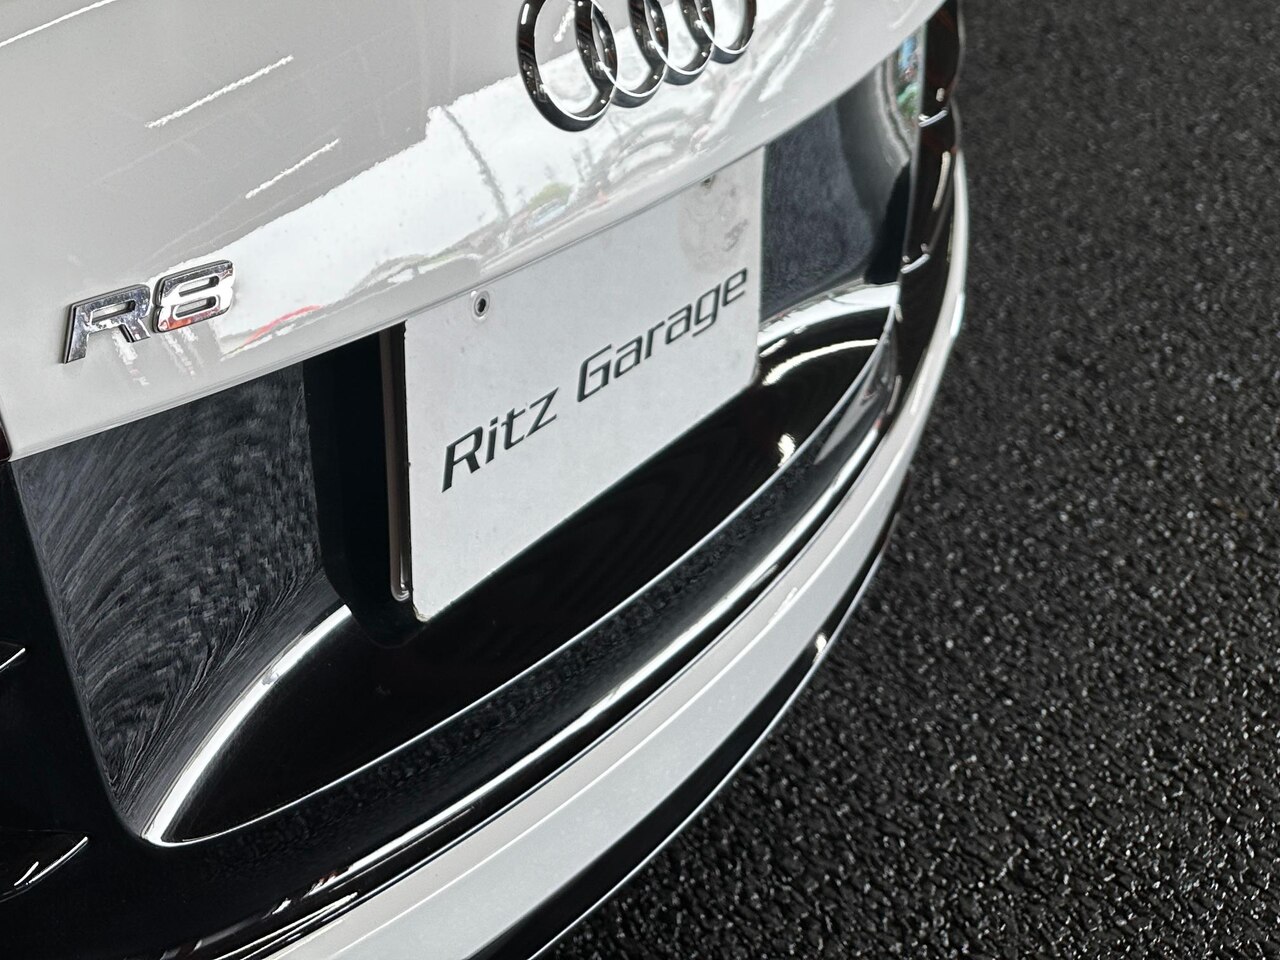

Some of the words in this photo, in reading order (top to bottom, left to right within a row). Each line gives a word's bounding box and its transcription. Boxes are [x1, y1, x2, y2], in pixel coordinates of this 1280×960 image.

[62, 259, 234, 365] R8
[441, 386, 560, 494] Ritz
[576, 267, 749, 403] Garage
